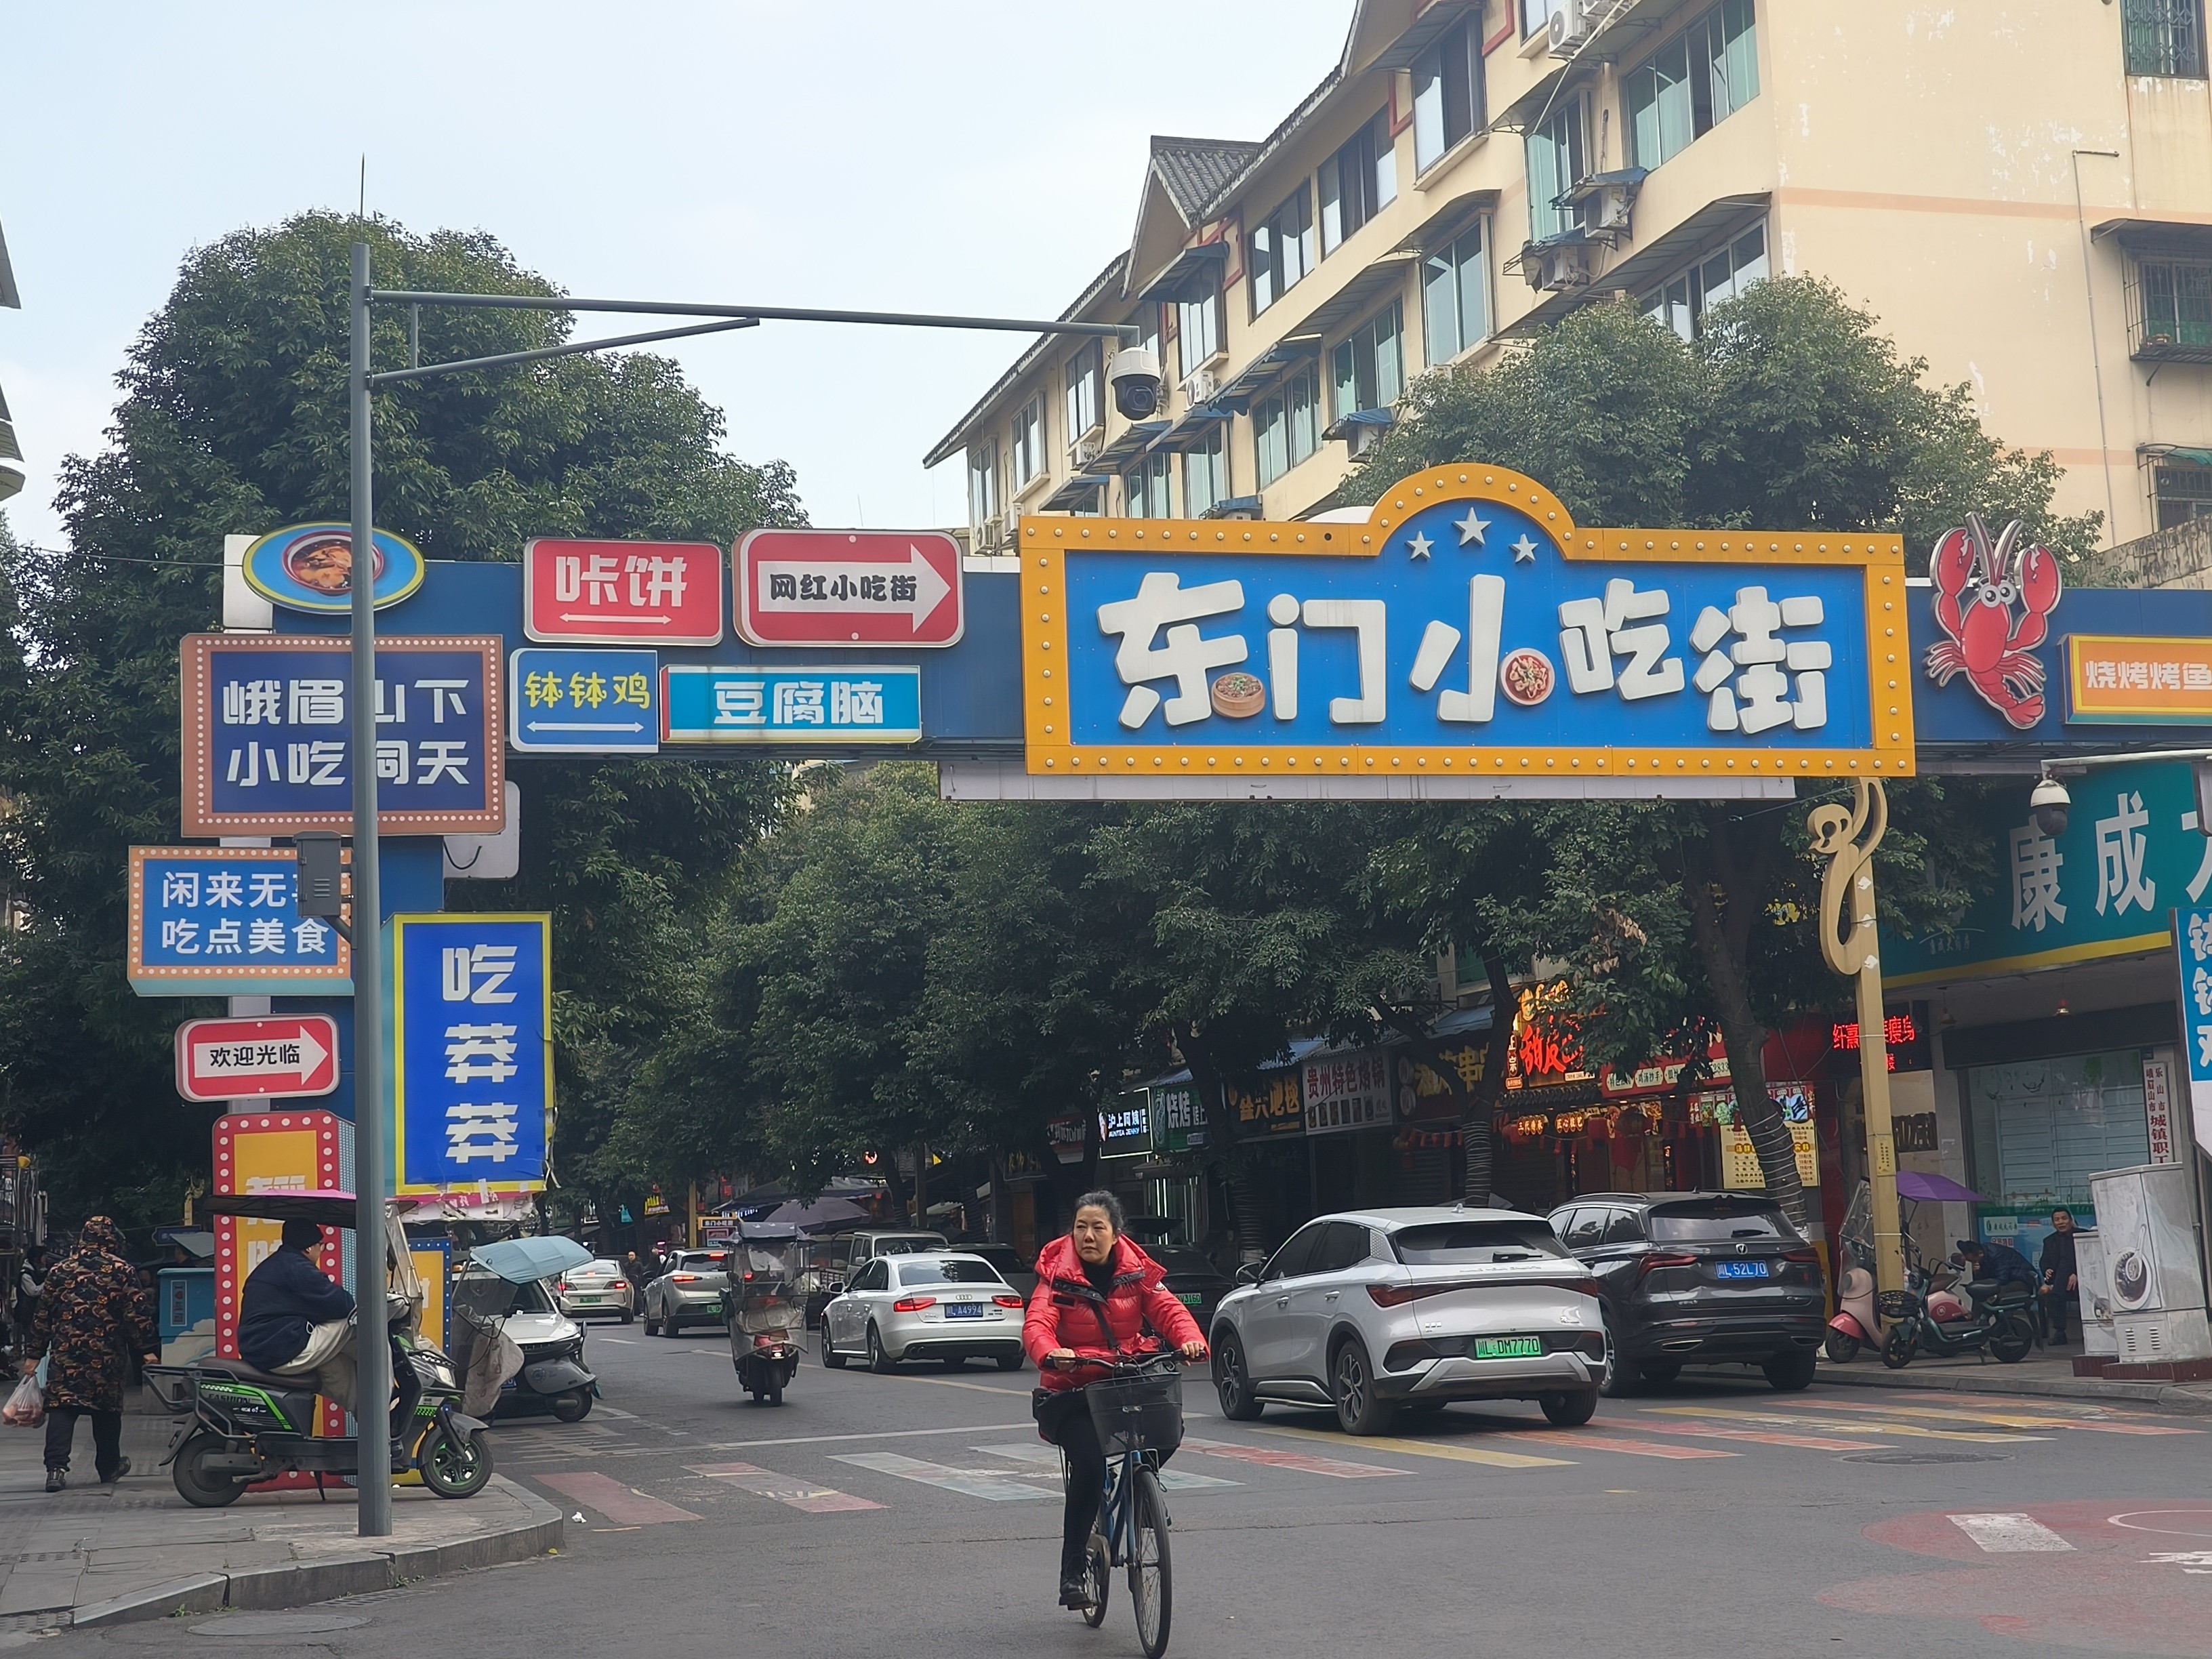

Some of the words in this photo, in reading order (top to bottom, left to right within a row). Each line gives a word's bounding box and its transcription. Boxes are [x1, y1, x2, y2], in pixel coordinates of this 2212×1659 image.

[555, 554, 687, 607] 咔饼
[770, 573, 917, 602] 网红小吃街
[1097, 572, 1832, 735] 东门小吃街
[525, 670, 651, 710] 钵钵鸡
[2085, 660, 2212, 691] 烧烤烤鱼
[713, 681, 883, 724] 豆腐脑
[162, 871, 298, 909] 闲来无
[161, 918, 329, 955] 吃点美食
[209, 1044, 301, 1069] 欢迎光临
[441, 944, 520, 1164] 吃莽莽
[1166, 1091, 1191, 1128] 烧烤
[2146, 1067, 2156, 1113] 峨眉山市
[2155, 1067, 2165, 1112] 乐山市
